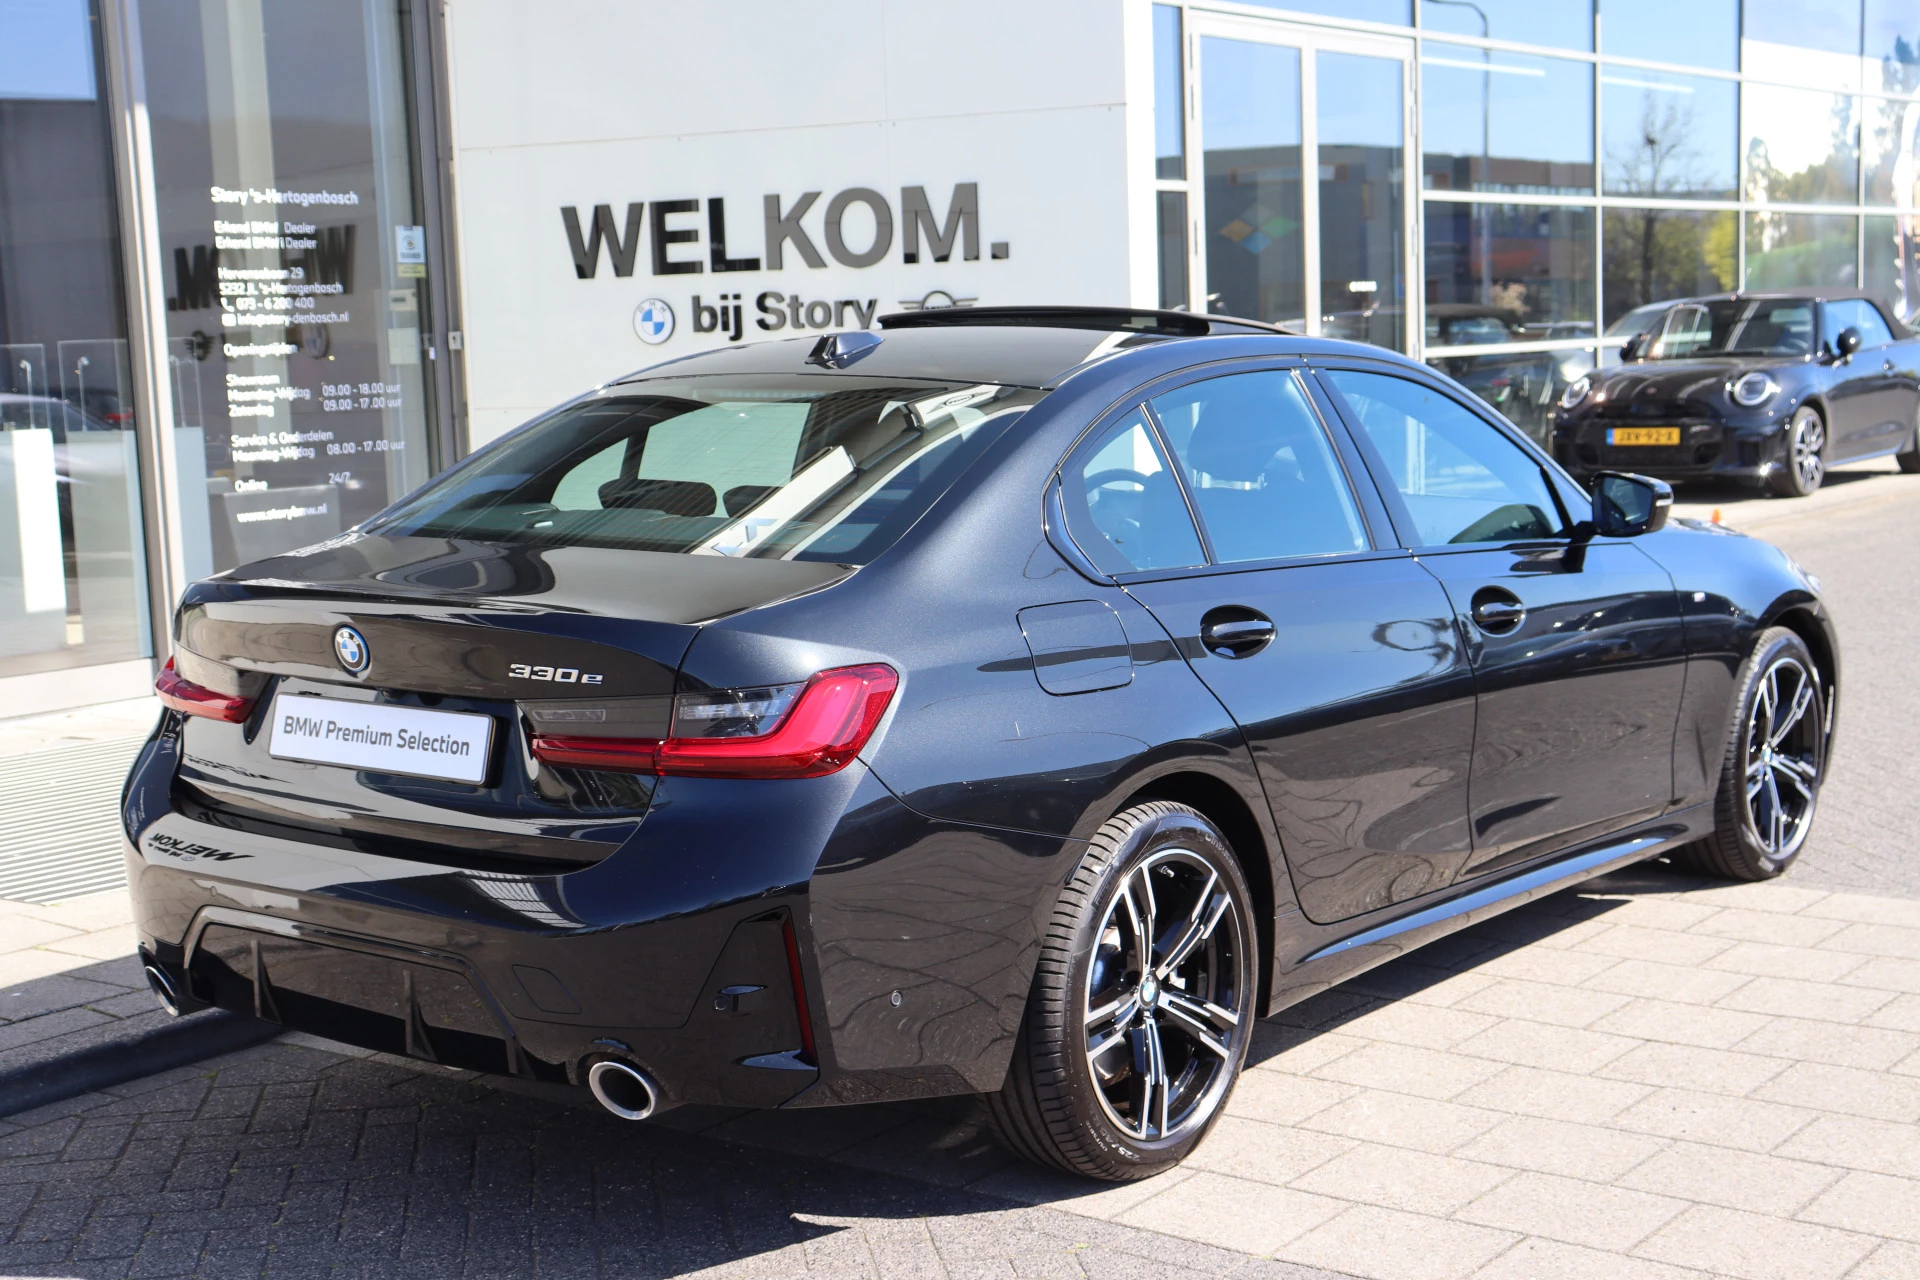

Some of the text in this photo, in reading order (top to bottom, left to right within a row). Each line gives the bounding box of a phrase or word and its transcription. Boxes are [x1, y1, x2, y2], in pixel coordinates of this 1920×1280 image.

[210, 186, 249, 206] Story
[213, 220, 251, 234] Erkend
[284, 222, 316, 235] Dealer
[560, 182, 1009, 279] WELKOM.
[214, 236, 252, 249] Erkend
[286, 237, 318, 249] Dealer
[290, 267, 305, 280] 29
[219, 282, 246, 295] 5232
[236, 297, 257, 310] 073
[294, 297, 316, 310] 400
[691, 291, 878, 341] bij Story
[226, 374, 280, 387] Showroom
[322, 384, 351, 397] 09.00
[358, 382, 385, 395] 18.00
[385, 383, 401, 393] uur
[228, 404, 275, 417] Zaterdag
[323, 398, 352, 412] 09.00
[359, 397, 386, 409] 17.00
[386, 398, 402, 407] uur
[231, 434, 268, 448] Service
[278, 430, 334, 444] Onderdelen
[326, 443, 355, 456] 08.00
[362, 440, 389, 452] 17.00
[390, 441, 405, 450] uur
[234, 472, 351, 493] Online 24/7
[508, 663, 603, 684] 330e
[283, 715, 470, 756] BMW Premium Selection
